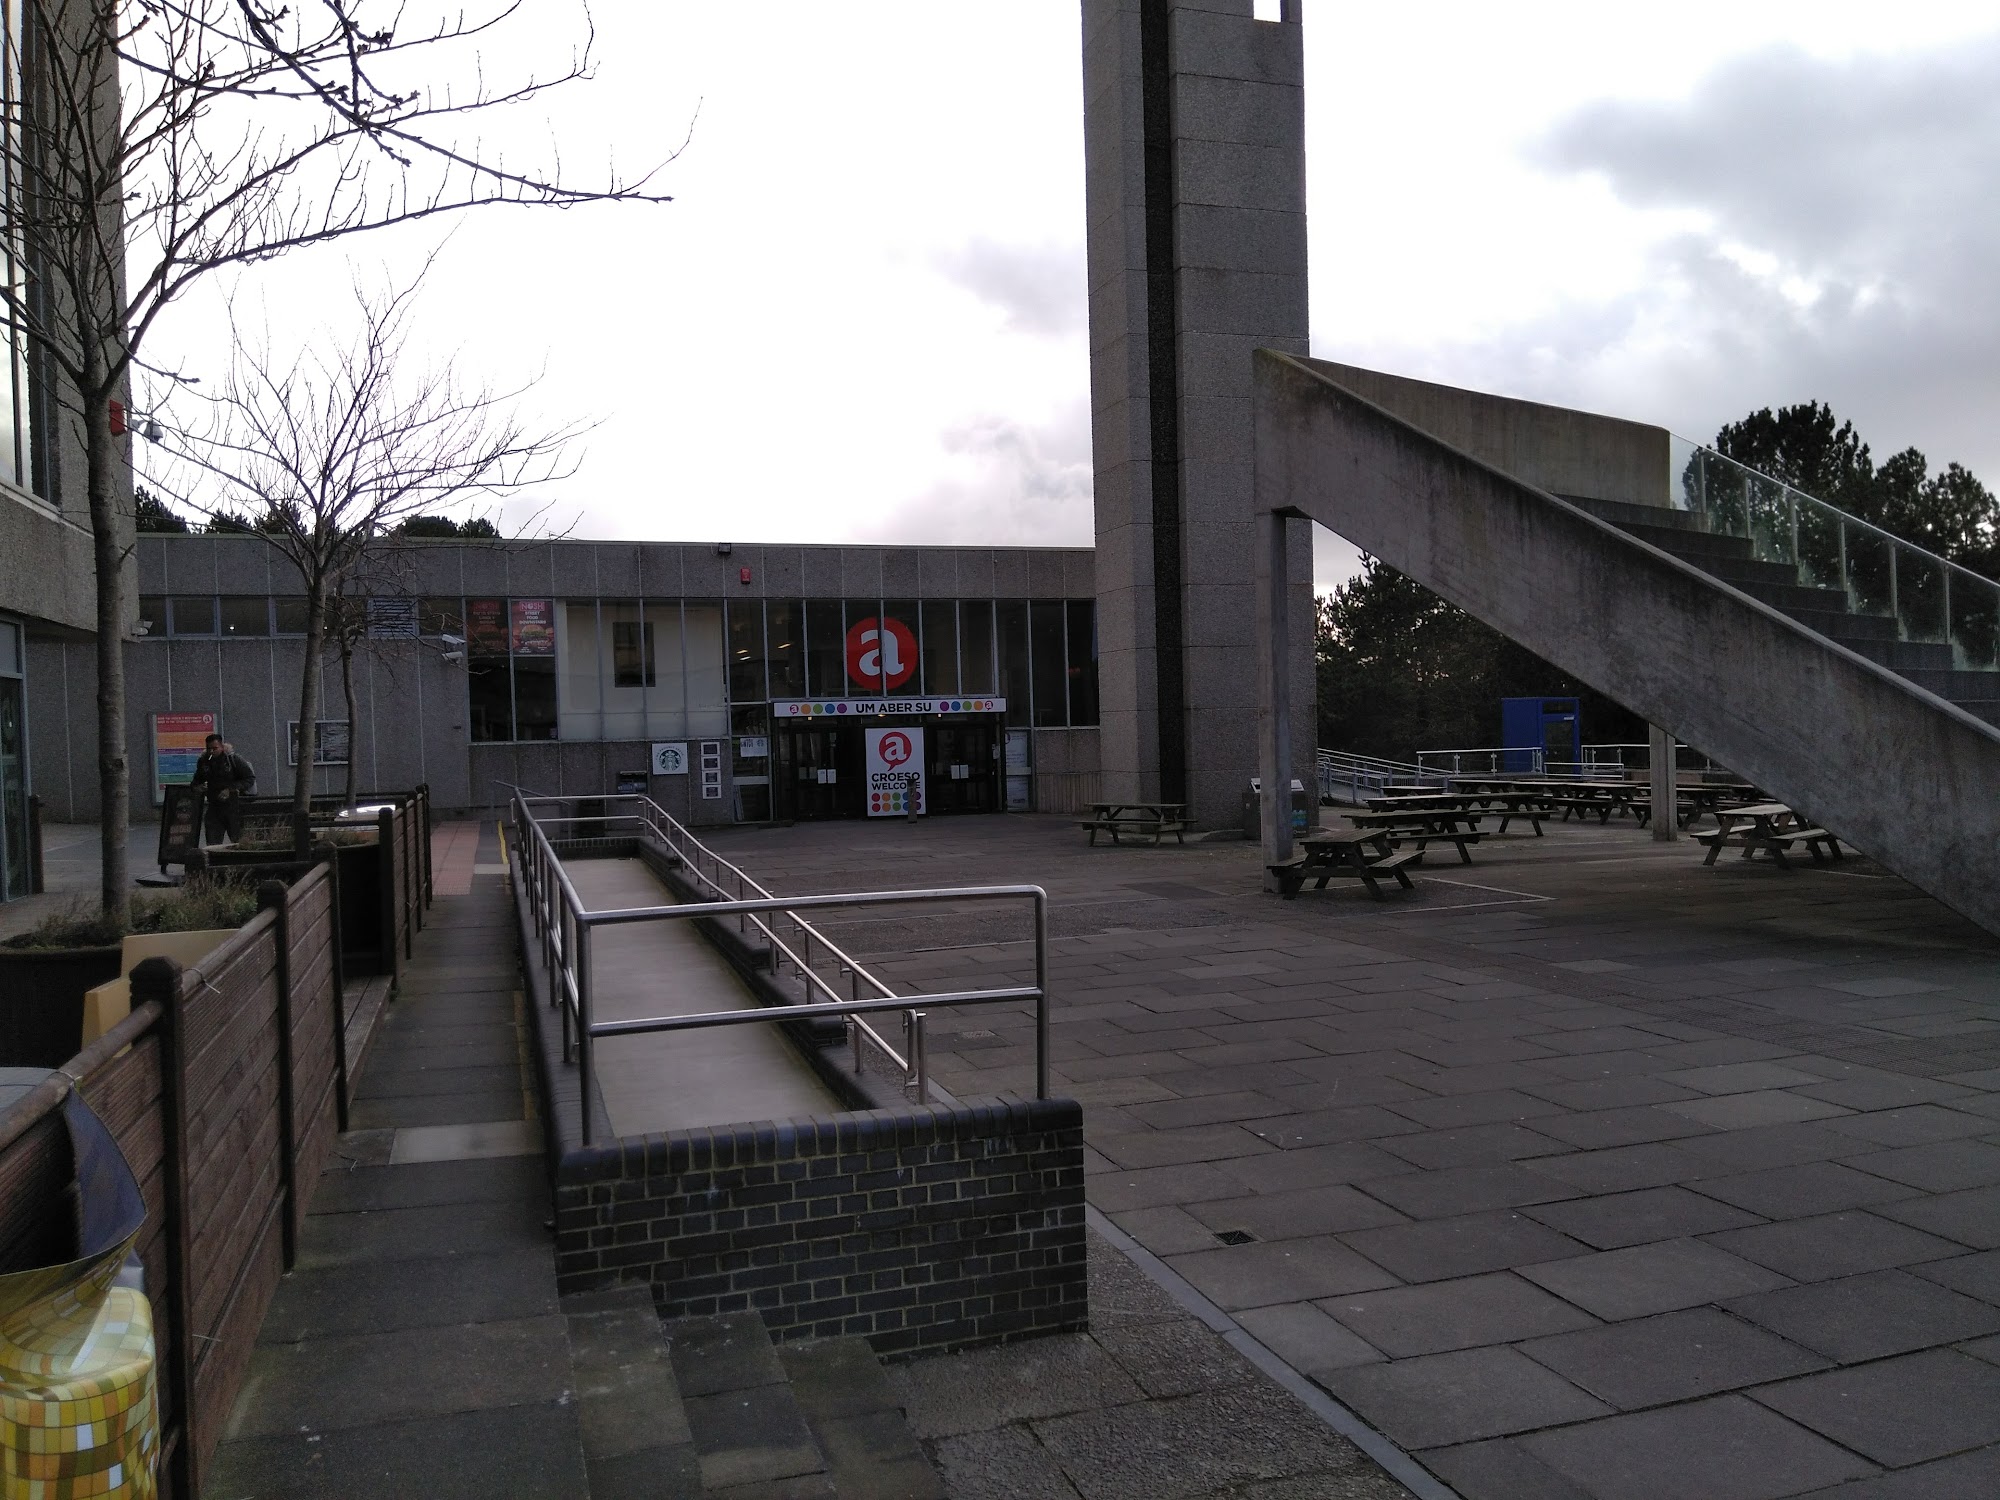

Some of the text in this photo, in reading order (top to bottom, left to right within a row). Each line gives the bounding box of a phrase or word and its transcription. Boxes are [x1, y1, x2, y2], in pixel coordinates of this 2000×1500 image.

[521, 602, 543, 610] NOSH
[855, 703, 876, 713] UM
[878, 702, 912, 713] ABER
[915, 702, 932, 712] SU
[871, 772, 921, 782] CROESO
[871, 781, 921, 791] WELCOE
